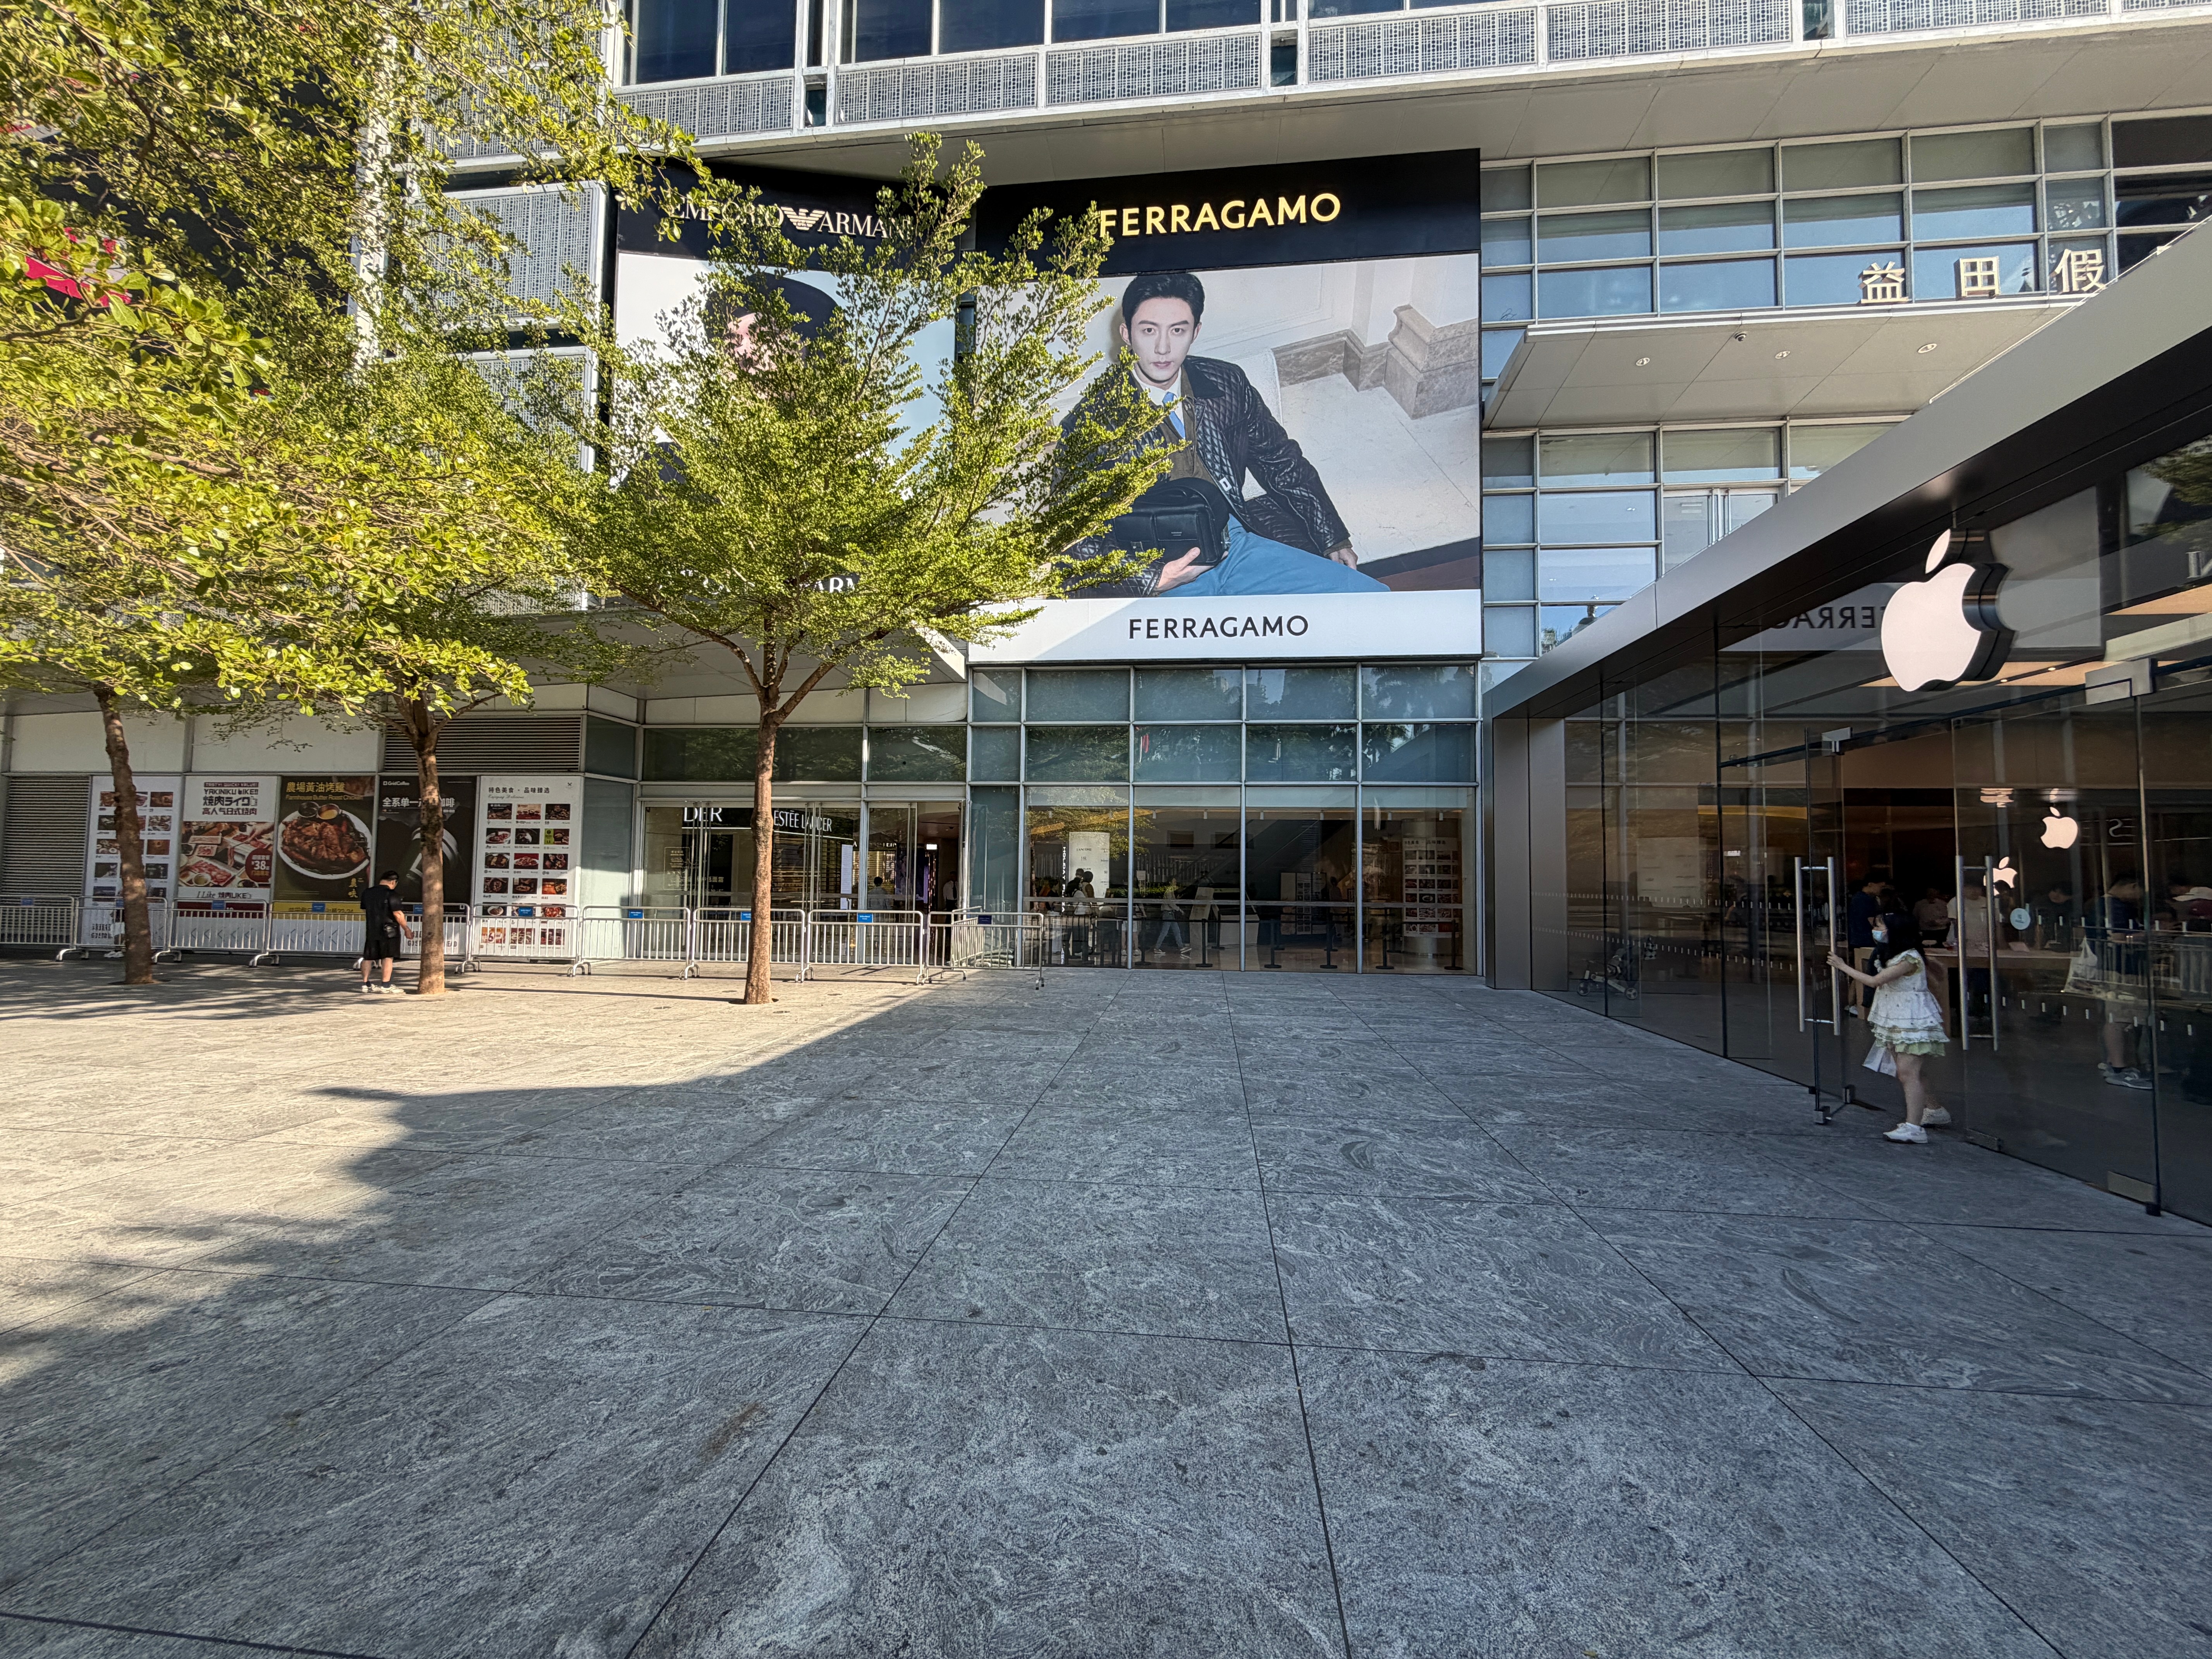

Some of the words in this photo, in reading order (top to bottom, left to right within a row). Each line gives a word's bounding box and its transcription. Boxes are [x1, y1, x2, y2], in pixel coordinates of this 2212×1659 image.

[1099, 193, 1340, 237] FERRAGAMO
[1860, 248, 2106, 304] 益田假
[1129, 615, 1309, 639] FERRAGAMO
